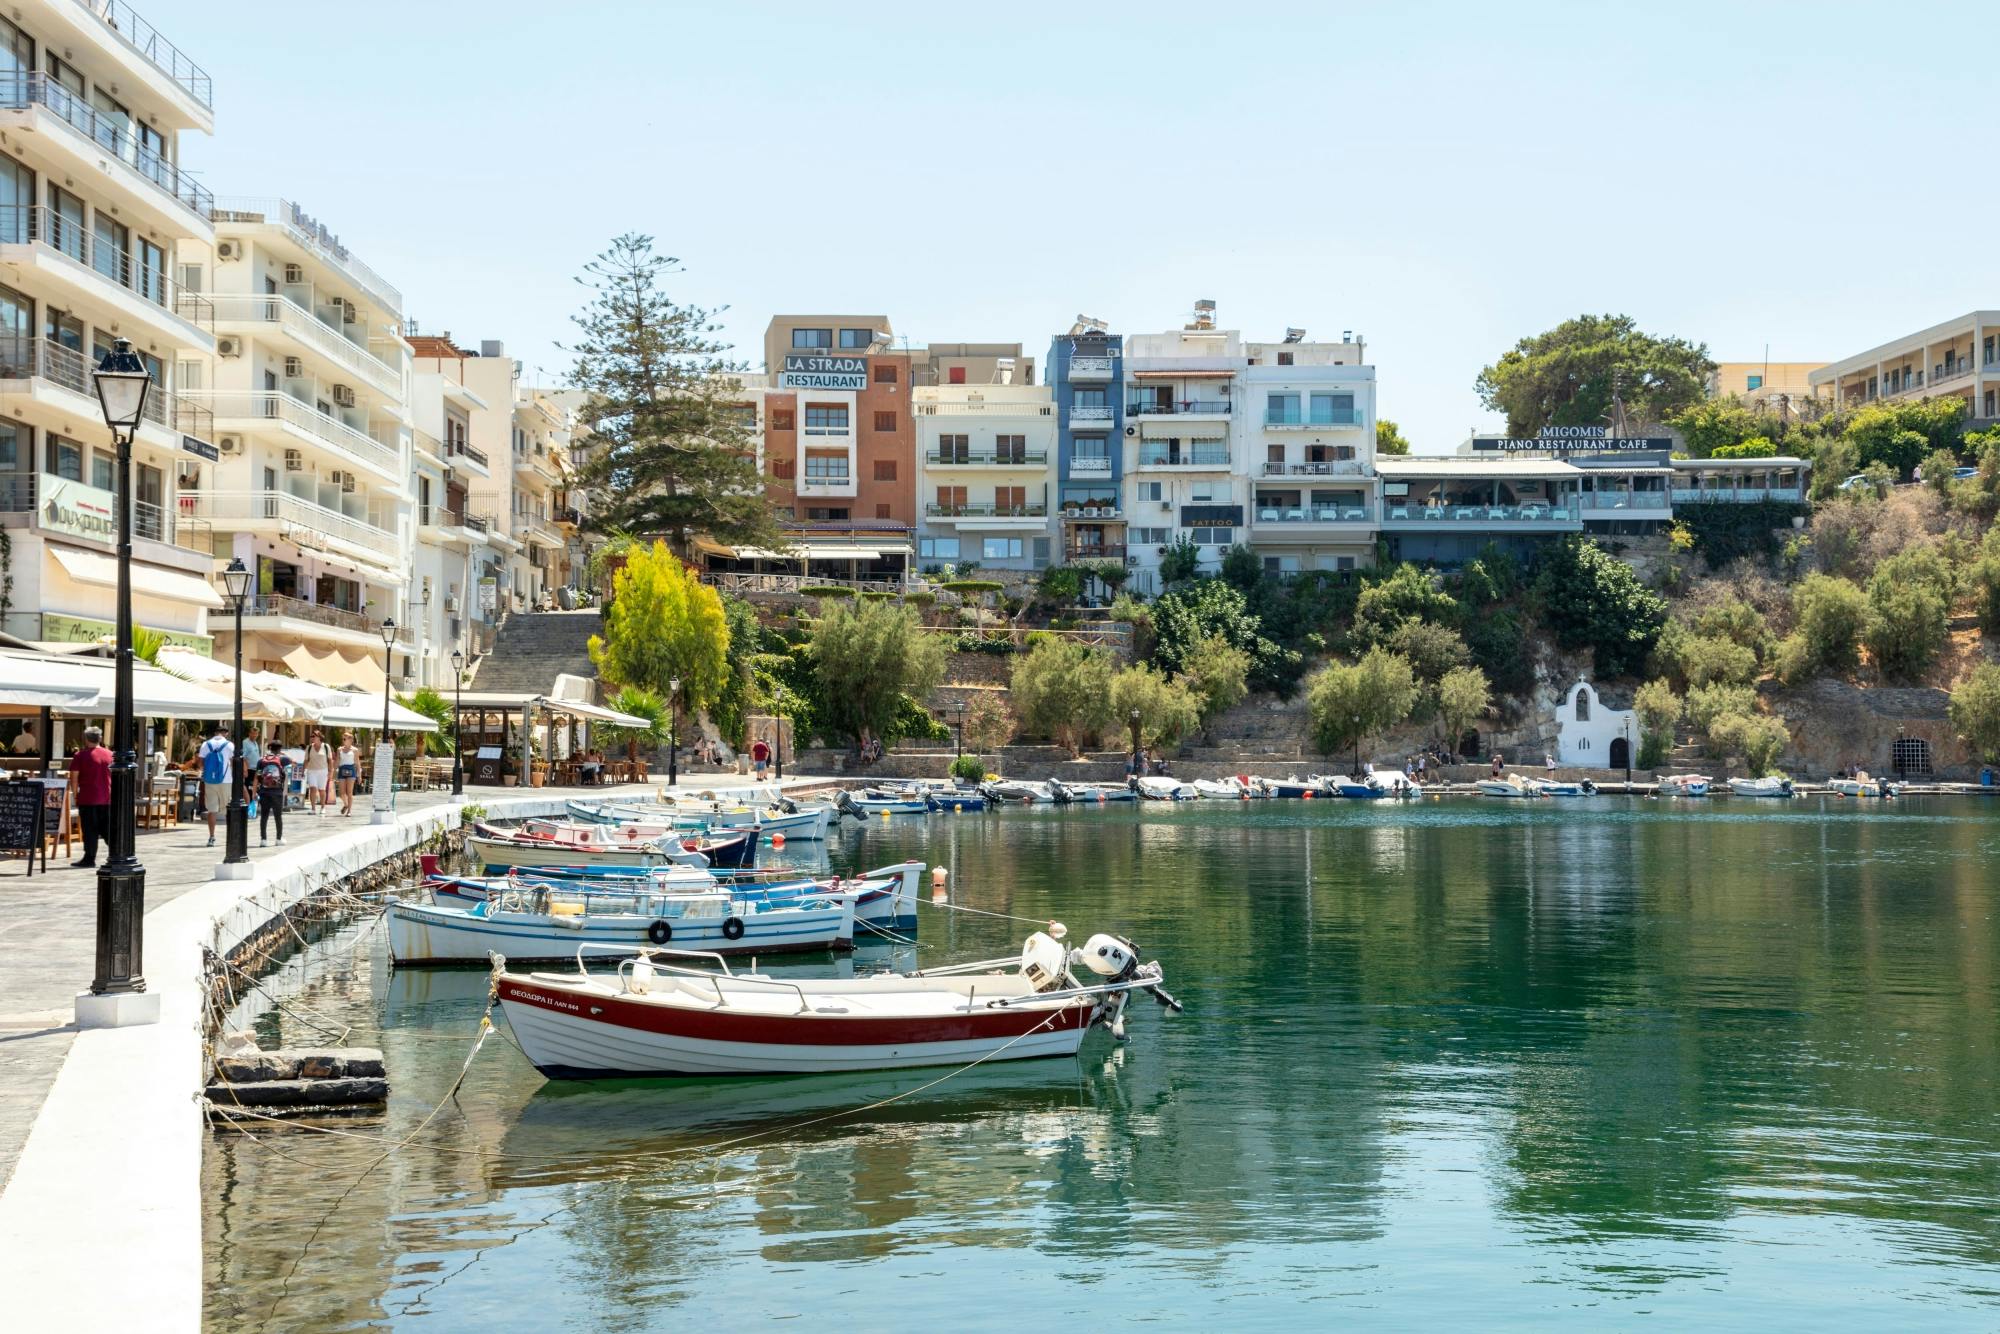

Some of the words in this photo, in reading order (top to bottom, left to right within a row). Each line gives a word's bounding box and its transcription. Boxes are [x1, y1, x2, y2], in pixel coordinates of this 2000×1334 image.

[787, 358, 805, 370] LA
[808, 358, 865, 371] STRADA
[787, 375, 865, 387] RESTAURANT
[1542, 426, 1605, 437] MIGOMIS
[1497, 440, 1533, 449] PIANO
[1538, 440, 1613, 449] RESTAURANT
[1619, 440, 1648, 449] CAFE
[510, 989, 546, 1003] ΘΕΟΔΩΡΑ
[568, 1003, 579, 1011] 844
